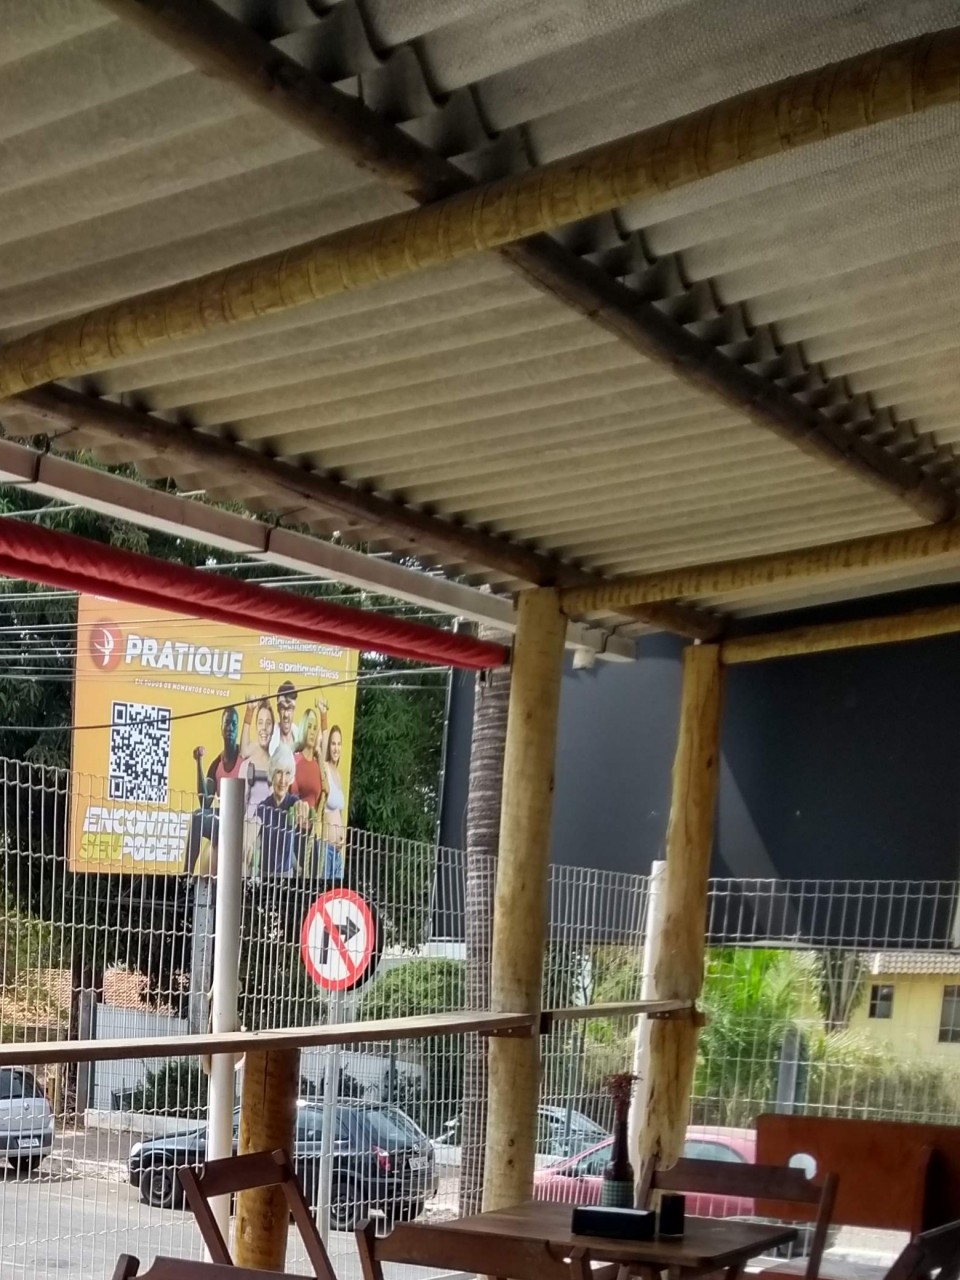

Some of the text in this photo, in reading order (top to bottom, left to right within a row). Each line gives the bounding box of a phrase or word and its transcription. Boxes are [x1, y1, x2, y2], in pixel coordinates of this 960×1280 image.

[126, 635, 243, 680] PRATIQUE
[260, 657, 275, 670] siga
[83, 806, 191, 837] ENCONTRE
[79, 833, 185, 861] SEU PODER
